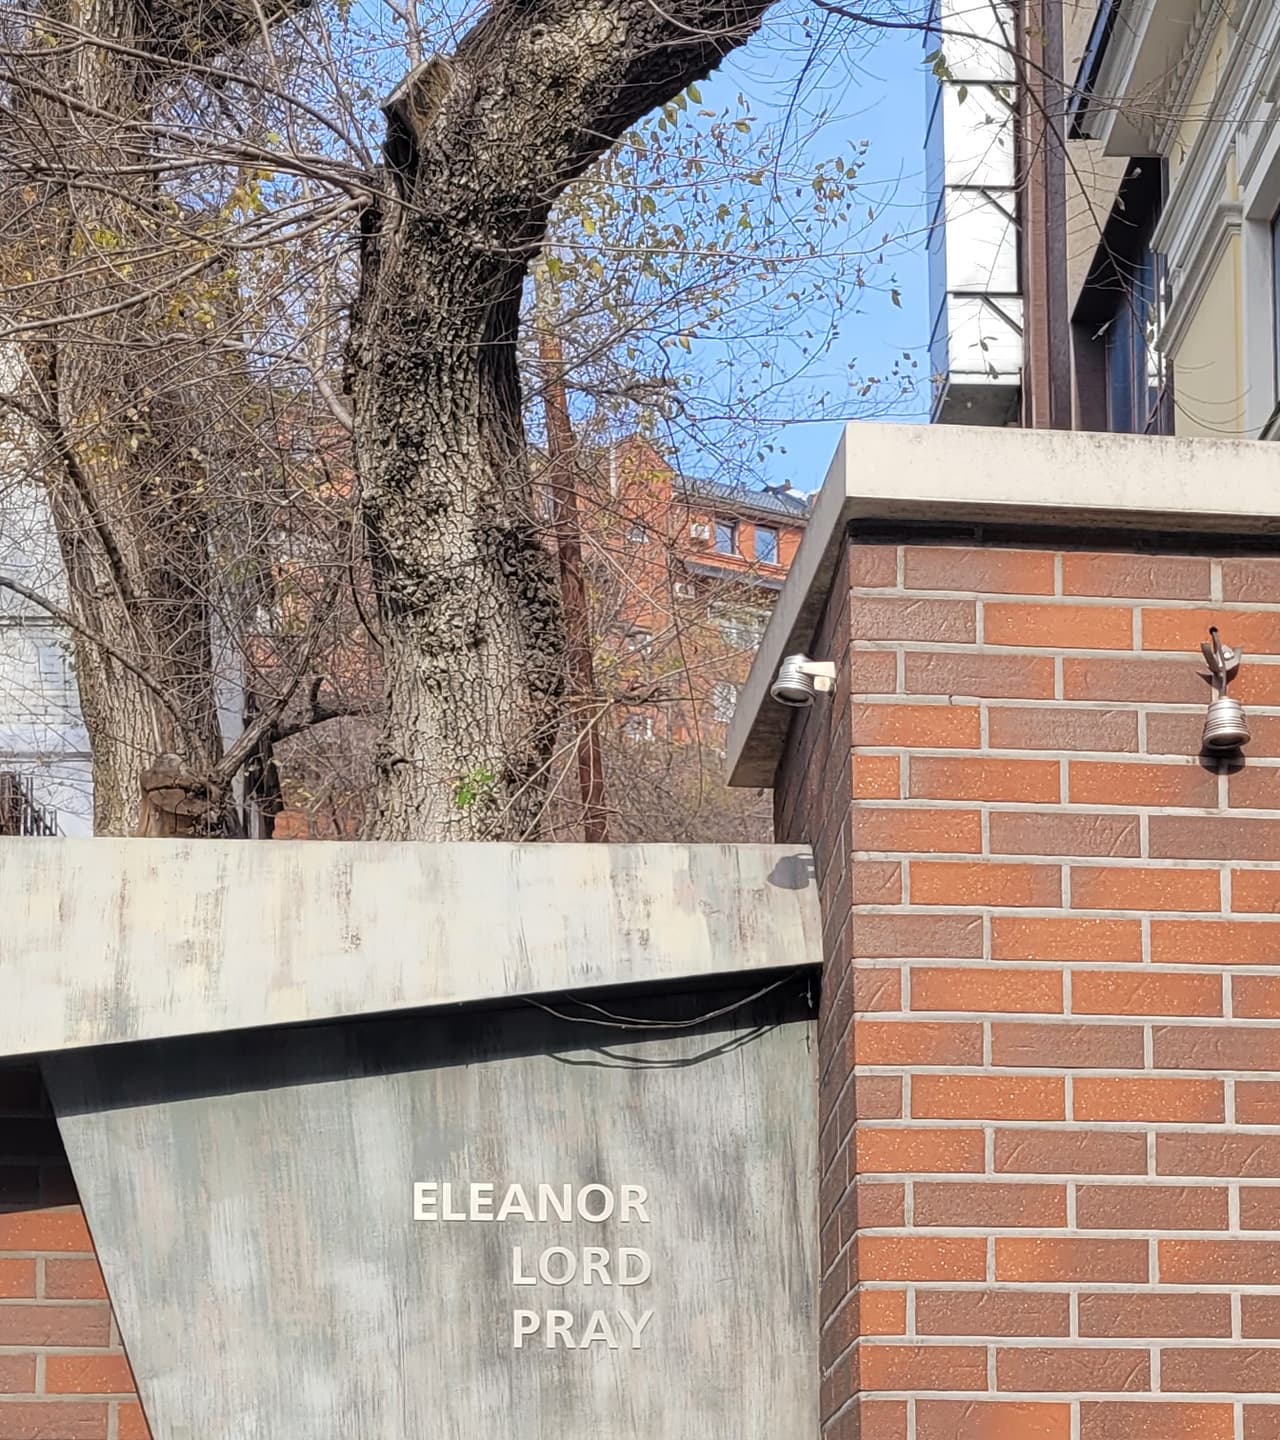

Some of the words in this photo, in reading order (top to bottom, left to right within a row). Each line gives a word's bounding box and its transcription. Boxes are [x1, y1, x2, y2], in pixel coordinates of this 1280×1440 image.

[412, 1182, 651, 1223] ELEANOR
[512, 1246, 653, 1287] LORD
[513, 1309, 655, 1350] PRAY
